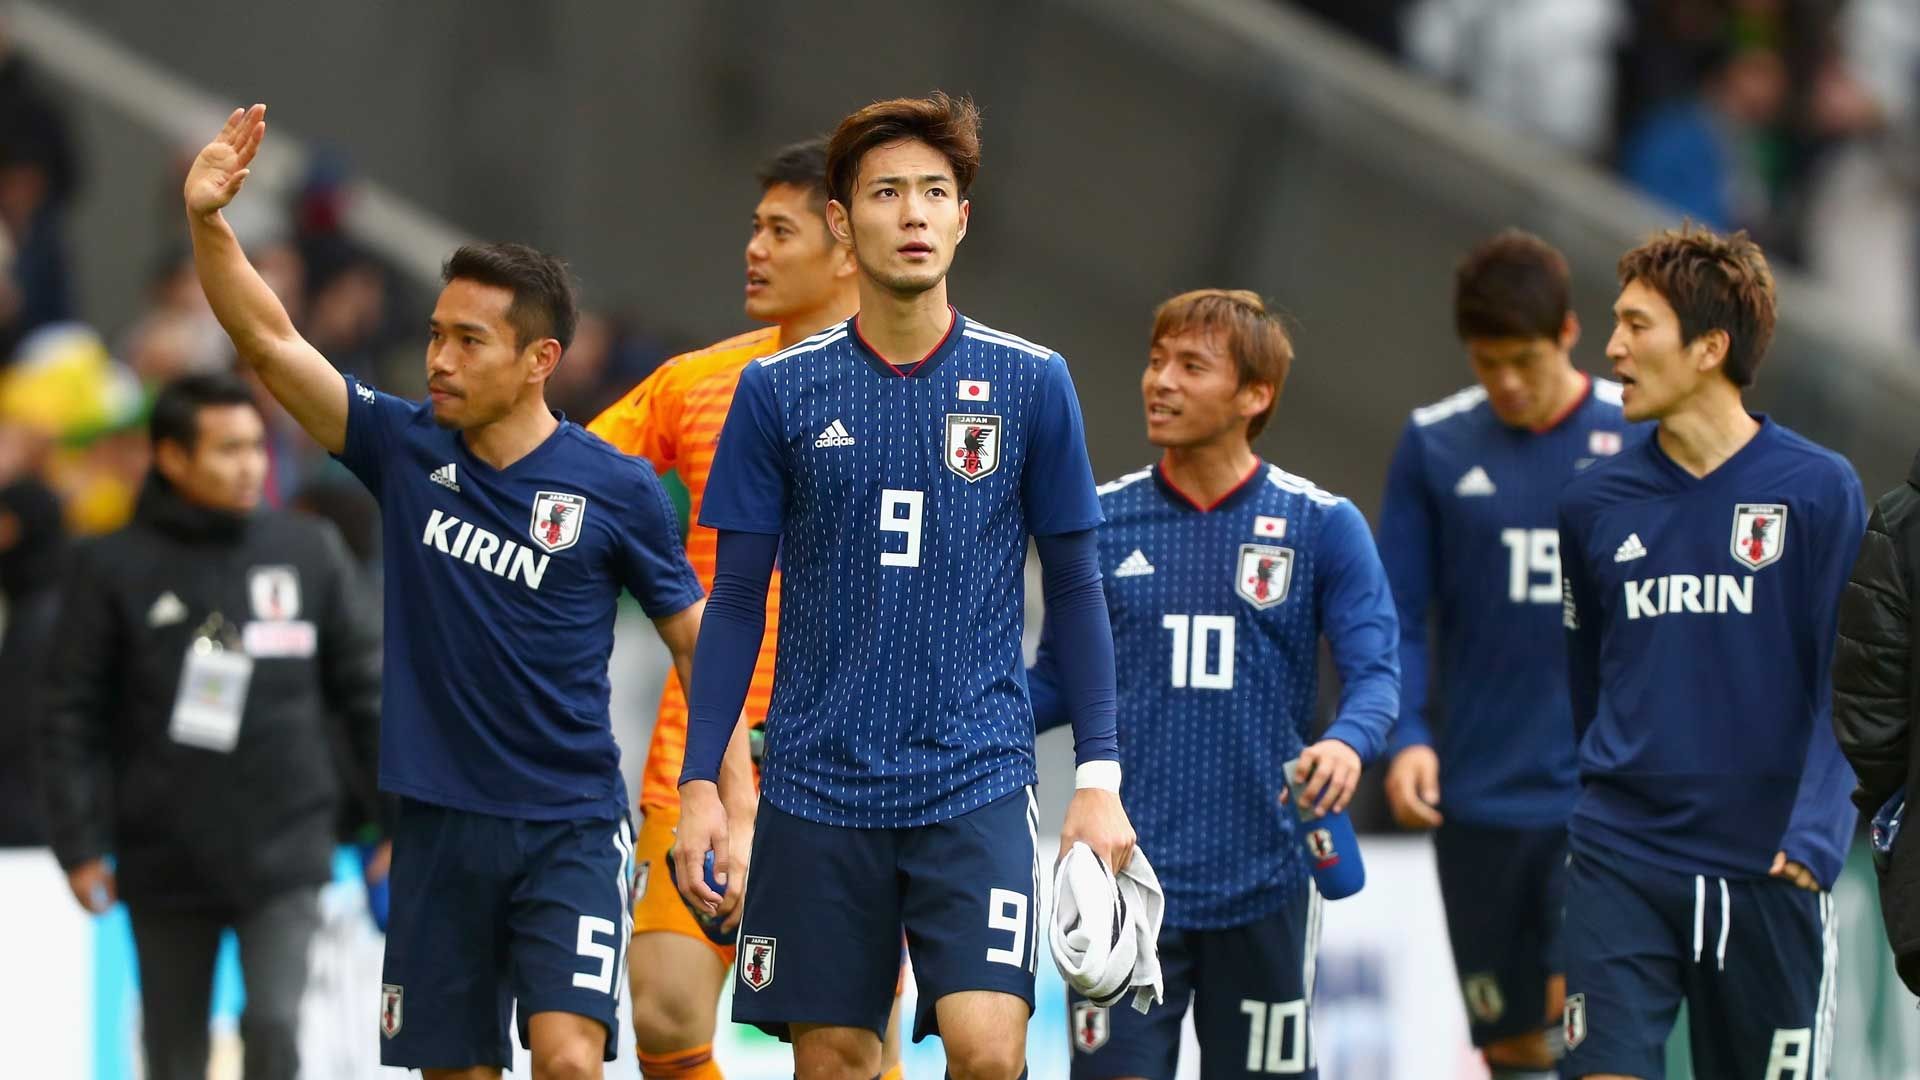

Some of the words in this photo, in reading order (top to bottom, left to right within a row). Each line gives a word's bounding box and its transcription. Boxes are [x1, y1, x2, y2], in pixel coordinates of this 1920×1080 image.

[815, 436, 854, 448] adidas
[961, 459, 983, 469] JFA
[429, 473, 461, 492] adidas
[548, 495, 574, 503] JAPAN
[422, 508, 551, 589] KIRIN
[879, 489, 923, 567] 9
[1624, 574, 1752, 619] KIRIN
[1163, 614, 1235, 689] 10
[573, 916, 615, 994] 5
[987, 888, 1027, 968] 9
[1241, 999, 1305, 1073] 10
